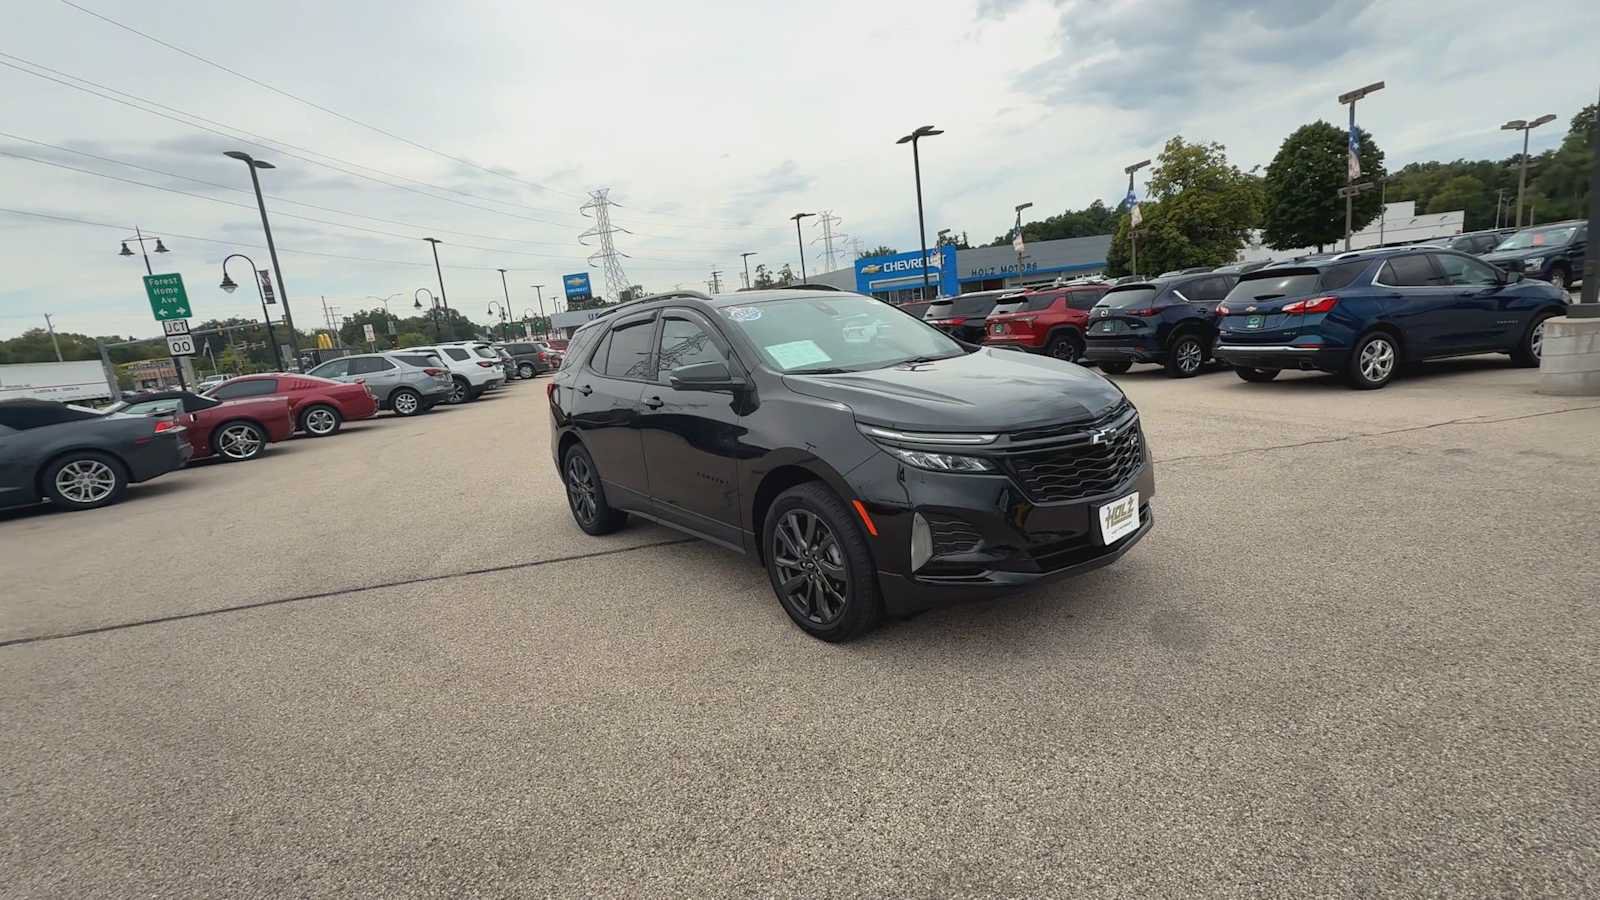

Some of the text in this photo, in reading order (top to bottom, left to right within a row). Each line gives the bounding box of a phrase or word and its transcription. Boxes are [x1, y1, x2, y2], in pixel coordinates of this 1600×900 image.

[883, 255, 946, 273] CHEVROLT
[148, 278, 178, 286] Forest
[153, 287, 179, 296] Home
[167, 322, 186, 333] JCT
[1105, 497, 1134, 529] HOLZ
